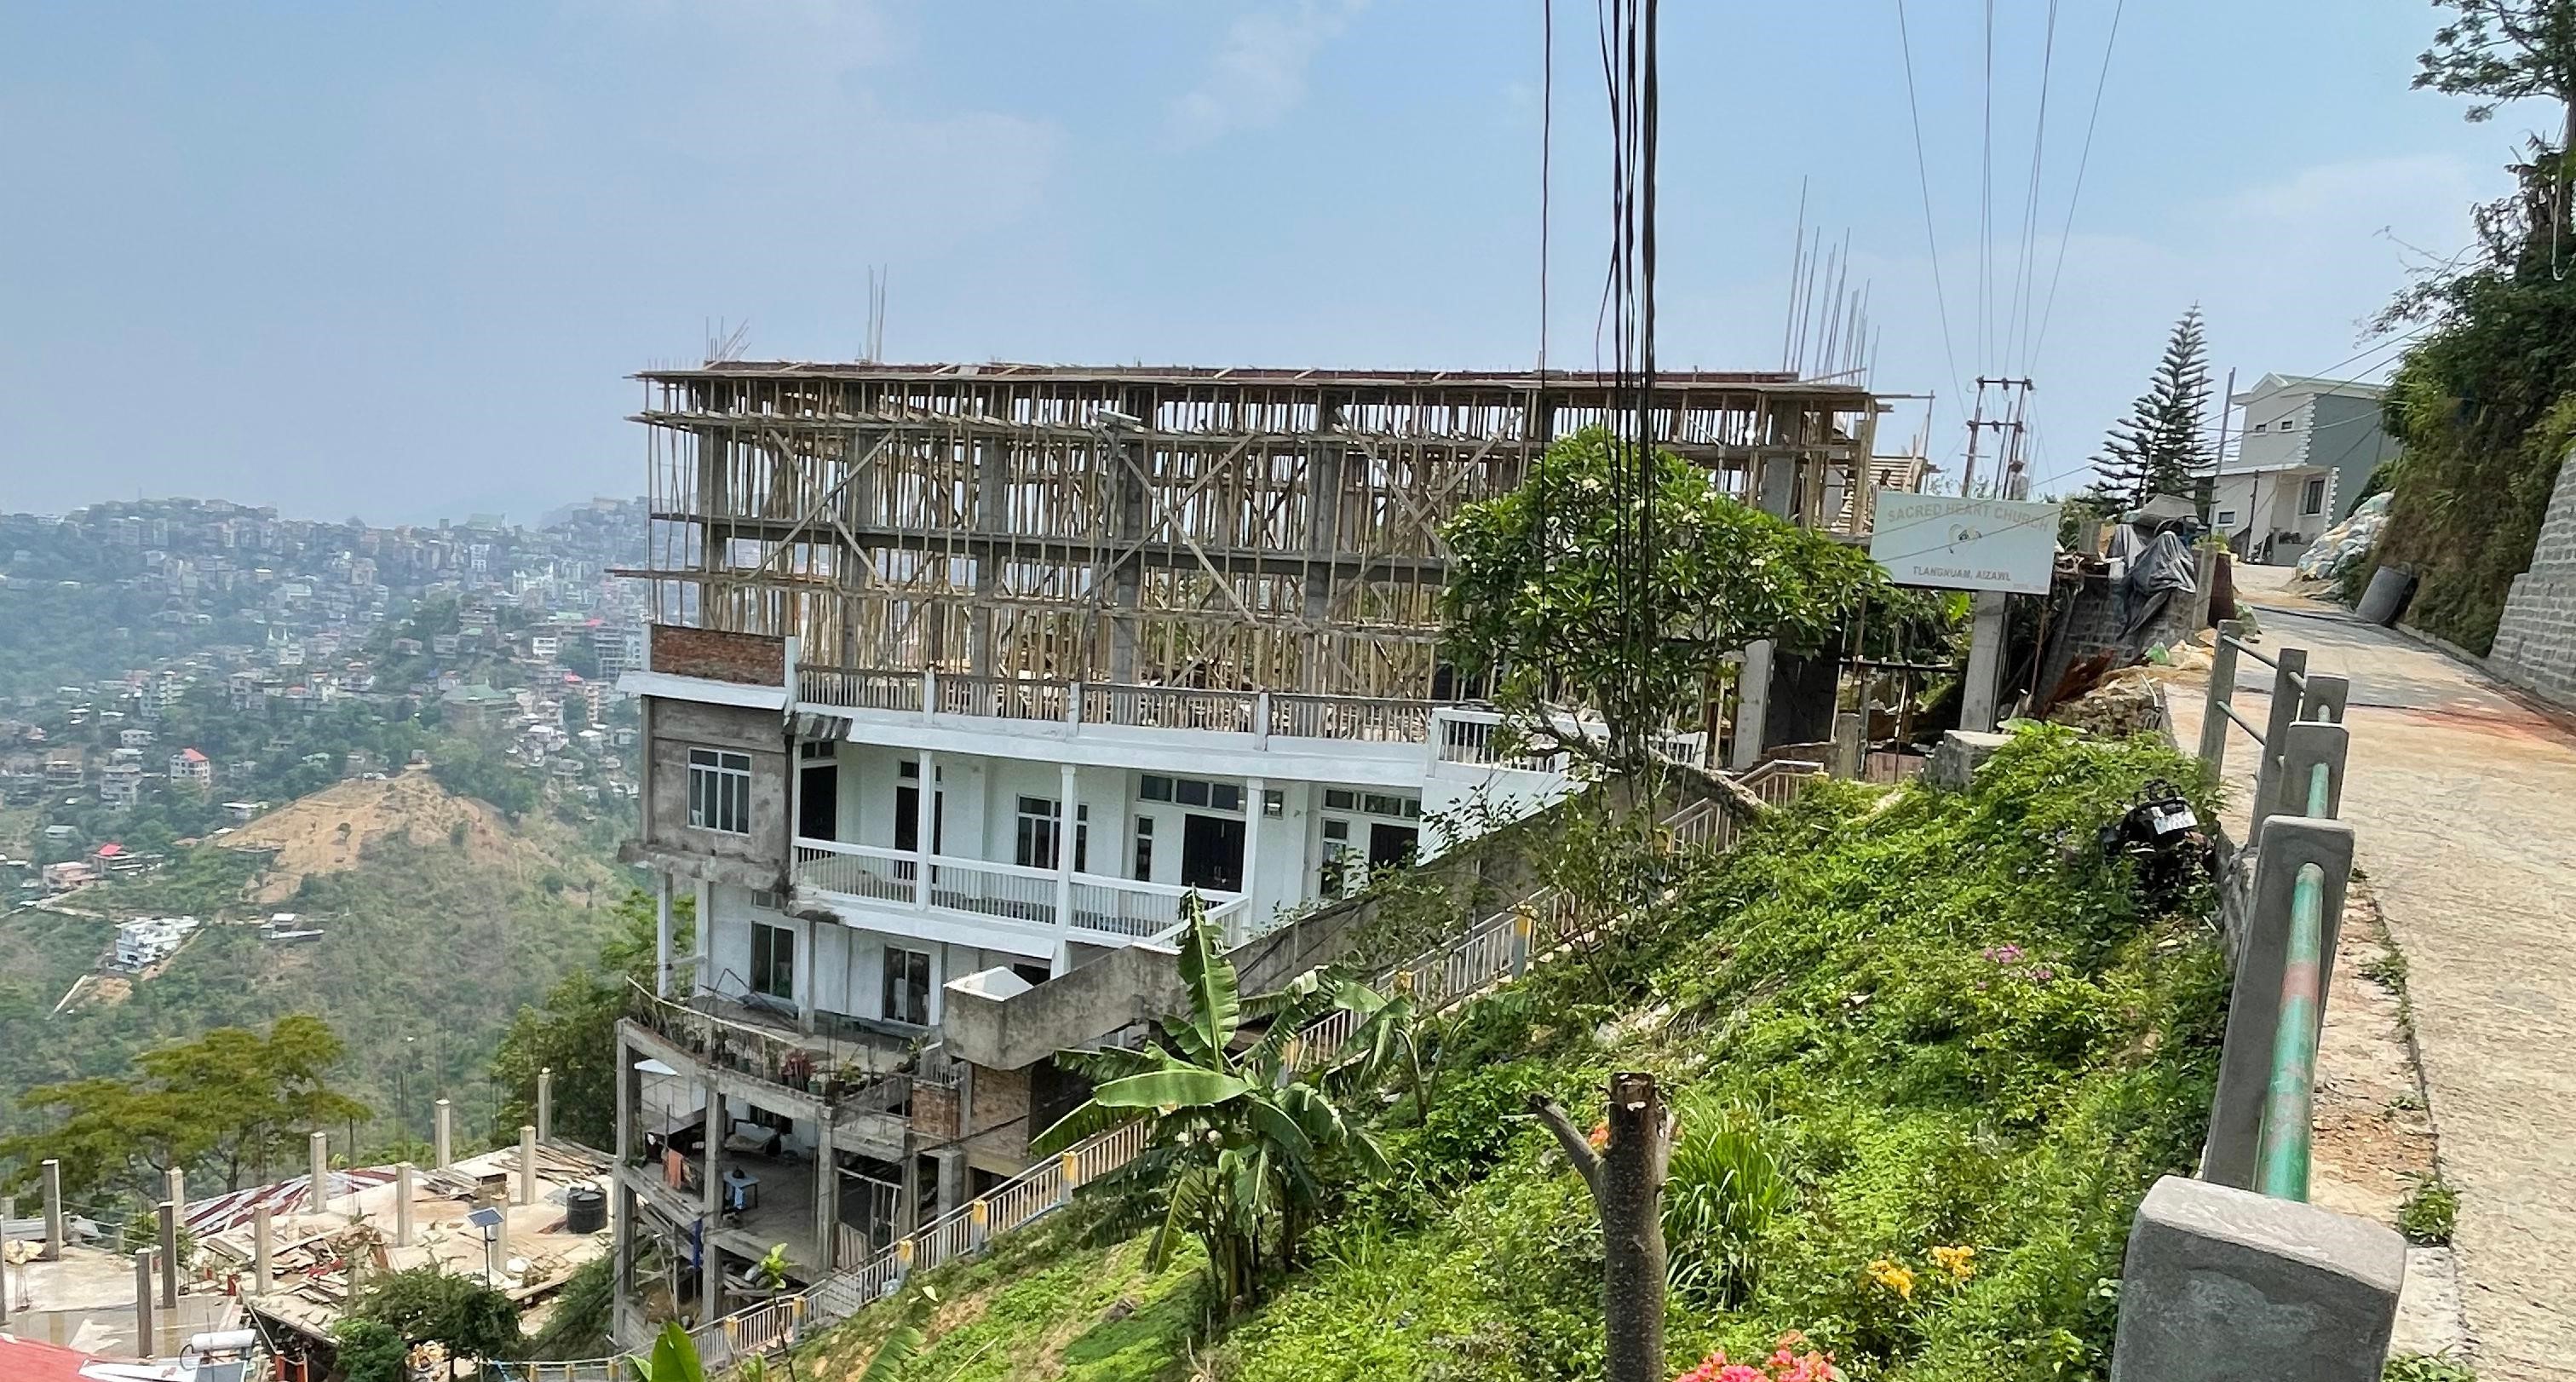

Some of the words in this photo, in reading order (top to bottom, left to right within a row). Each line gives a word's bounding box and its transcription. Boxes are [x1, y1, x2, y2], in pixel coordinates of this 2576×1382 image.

[1887, 503, 1942, 523] SACRED
[1946, 503, 1992, 517] HEART
[1994, 506, 2049, 532] CHURCH
[1975, 569, 2011, 581] AIZAWL
